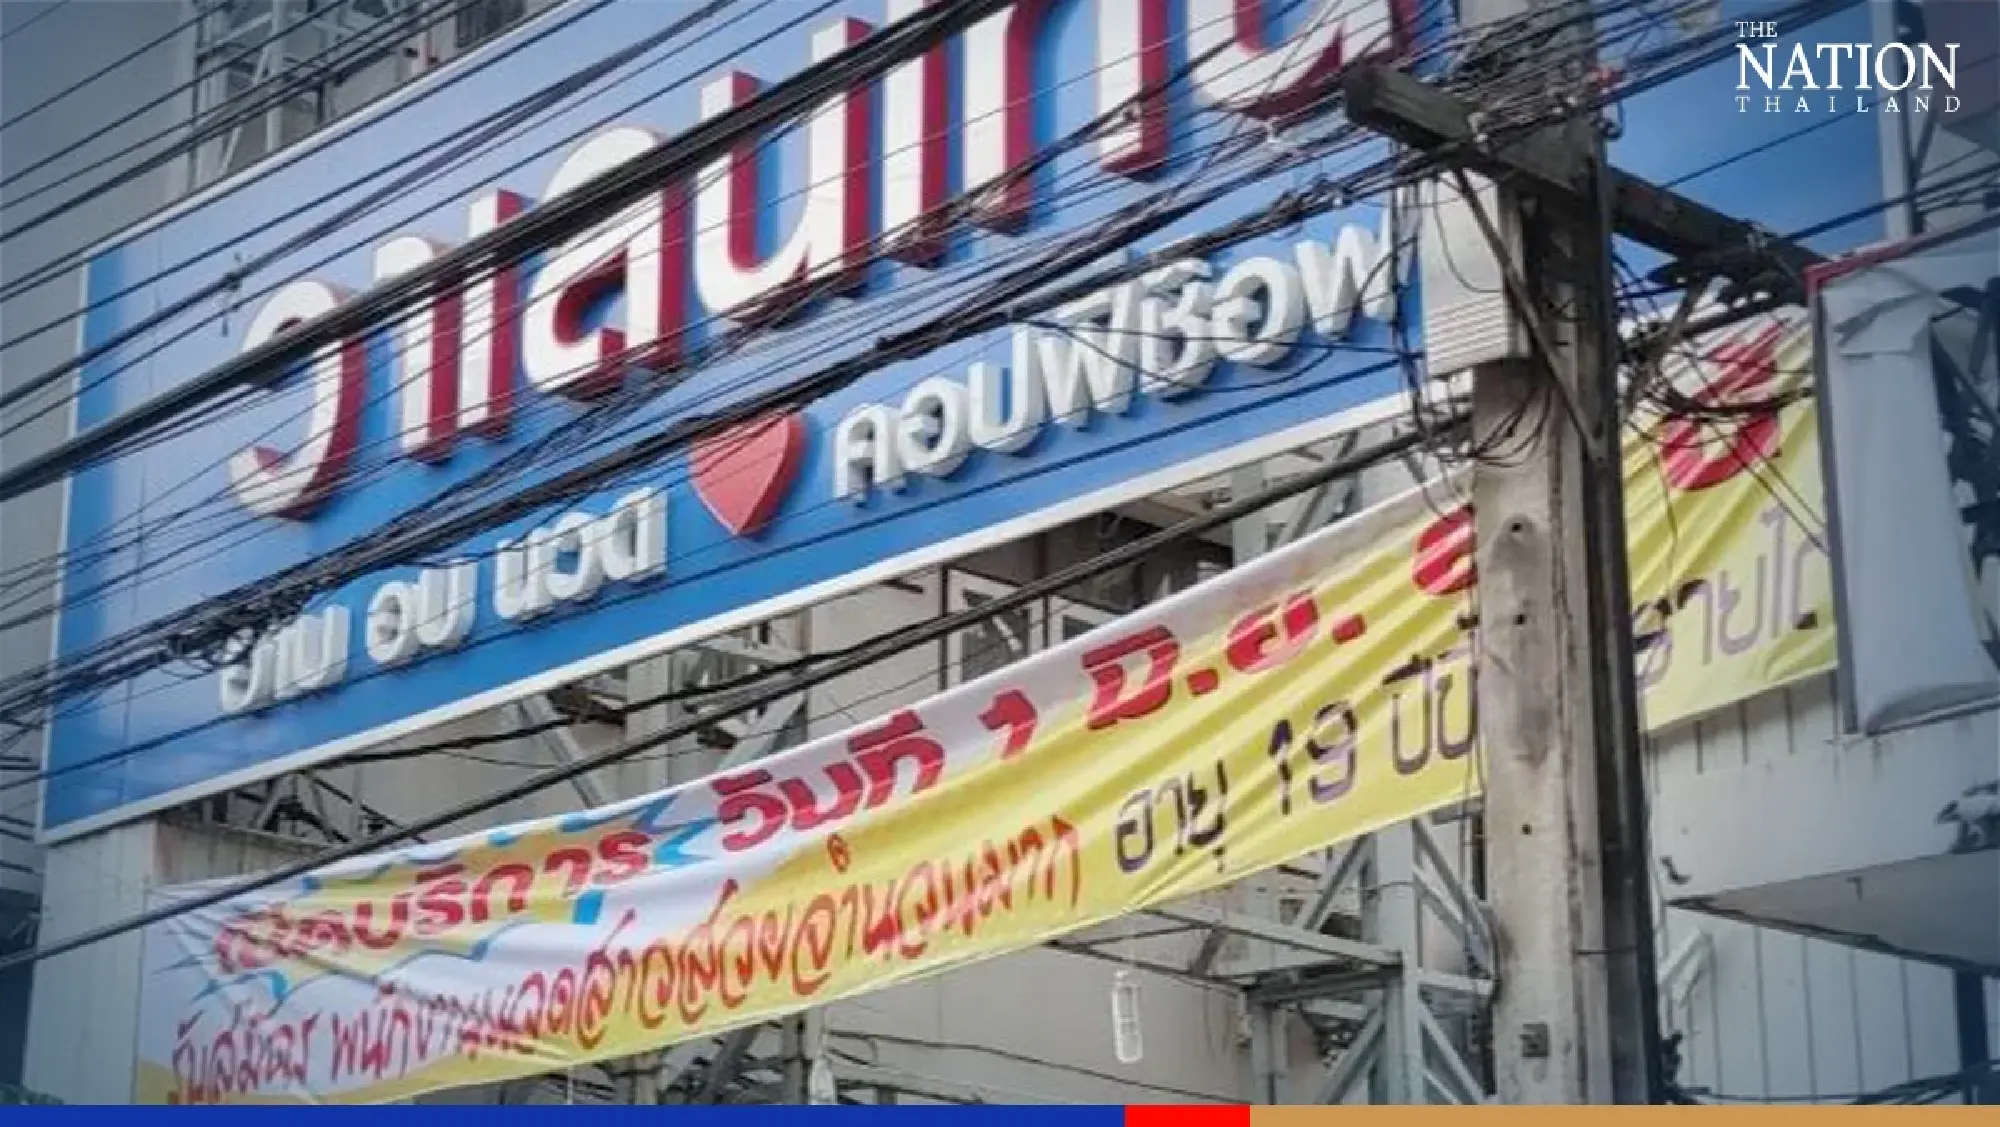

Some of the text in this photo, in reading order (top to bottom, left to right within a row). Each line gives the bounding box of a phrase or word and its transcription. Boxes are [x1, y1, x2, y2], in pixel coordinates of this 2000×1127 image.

[367, 558, 478, 664] อบ
[494, 487, 668, 620] นวด
[1268, 702, 1359, 816] 19
